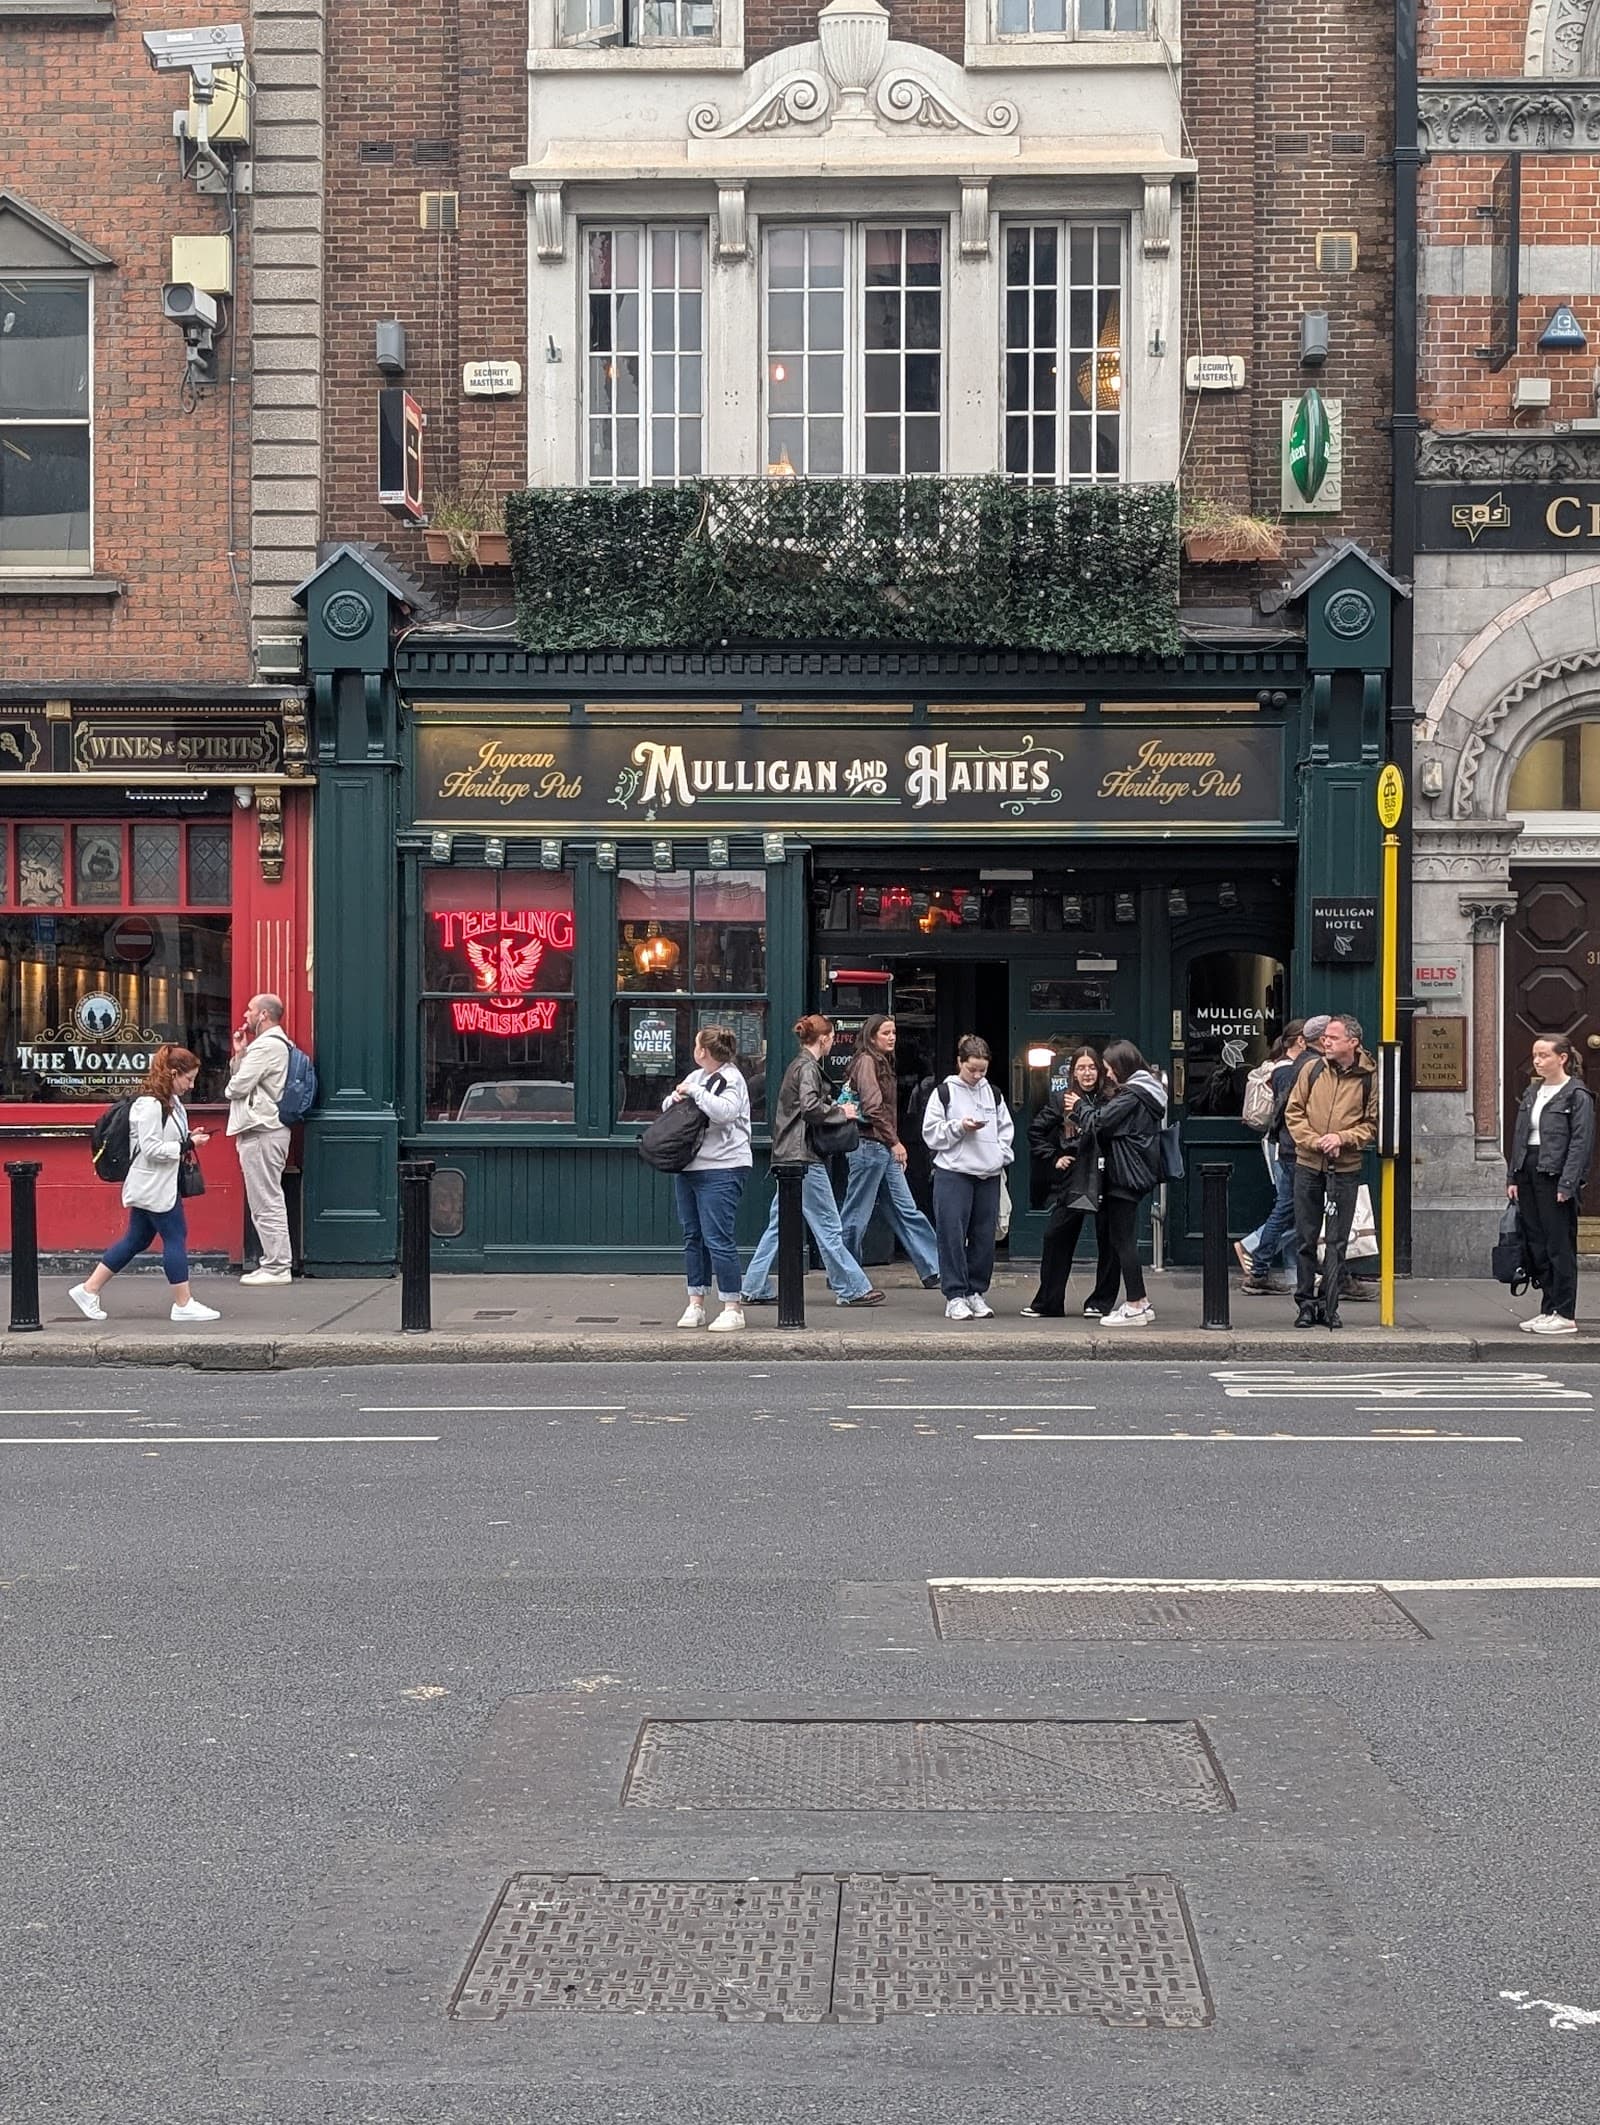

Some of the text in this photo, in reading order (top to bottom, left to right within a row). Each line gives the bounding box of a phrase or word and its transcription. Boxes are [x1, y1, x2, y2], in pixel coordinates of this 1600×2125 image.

[473, 369, 509, 377] SECURITY
[1455, 508, 1504, 520] ces
[89, 737, 264, 759] WINES & SPIRITS
[468, 741, 555, 773] Joycean
[1127, 739, 1216, 773] Joycean
[631, 741, 838, 807] MULLIGAN
[905, 741, 1050, 808] HAINES
[438, 772, 583, 806] Heritage Pub
[1097, 771, 1242, 805] Heritage Pub
[1315, 908, 1375, 917] MULLIGAN
[435, 911, 573, 948] TEELING
[1325, 920, 1363, 929] HOTEL
[1416, 967, 1457, 980] IELTS
[453, 1002, 557, 1035] WHISKEY
[1196, 1008, 1275, 1019] MULLIGAN
[633, 1030, 672, 1040] GAME
[1211, 1024, 1260, 1035] HOTEL
[633, 1041, 672, 1052] WEEK
[16, 1046, 66, 1070] THE
[47, 1077, 87, 1085] Traditional
